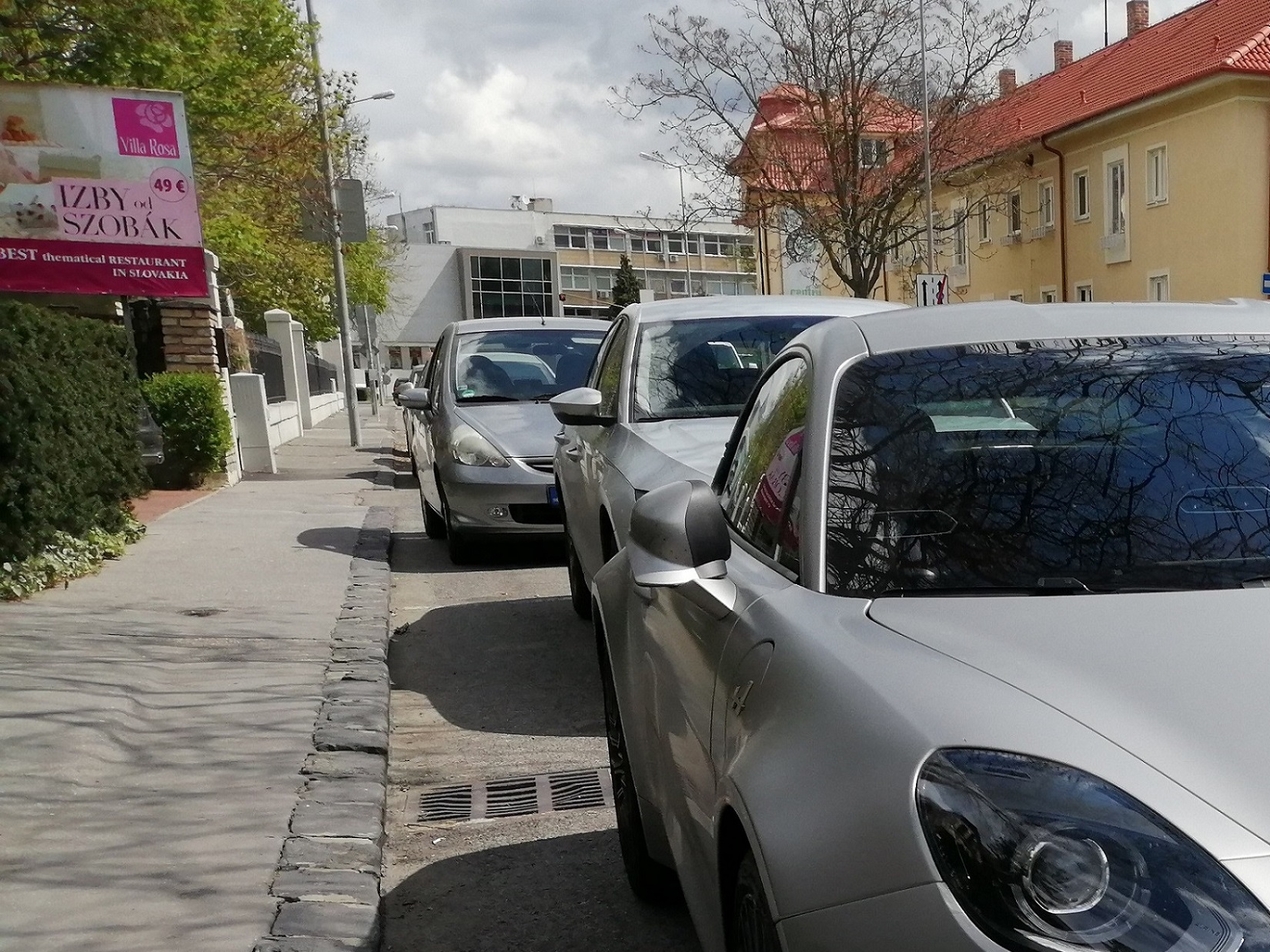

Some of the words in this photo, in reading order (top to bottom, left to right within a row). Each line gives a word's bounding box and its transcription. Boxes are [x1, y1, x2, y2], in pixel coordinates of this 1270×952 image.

[120, 136, 147, 154] Villa
[149, 139, 177, 156] Rosa
[154, 179, 172, 192] 49
[176, 180, 186, 193] €
[59, 184, 130, 211] IZBY
[134, 197, 153, 210] od
[62, 211, 182, 240] SZOBÁK
[0, 247, 38, 261] BEST
[42, 252, 105, 264] thematical
[109, 256, 187, 267] RESTAURANT
[113, 268, 127, 277] IN
[129, 269, 188, 280] SLOVAKIA
